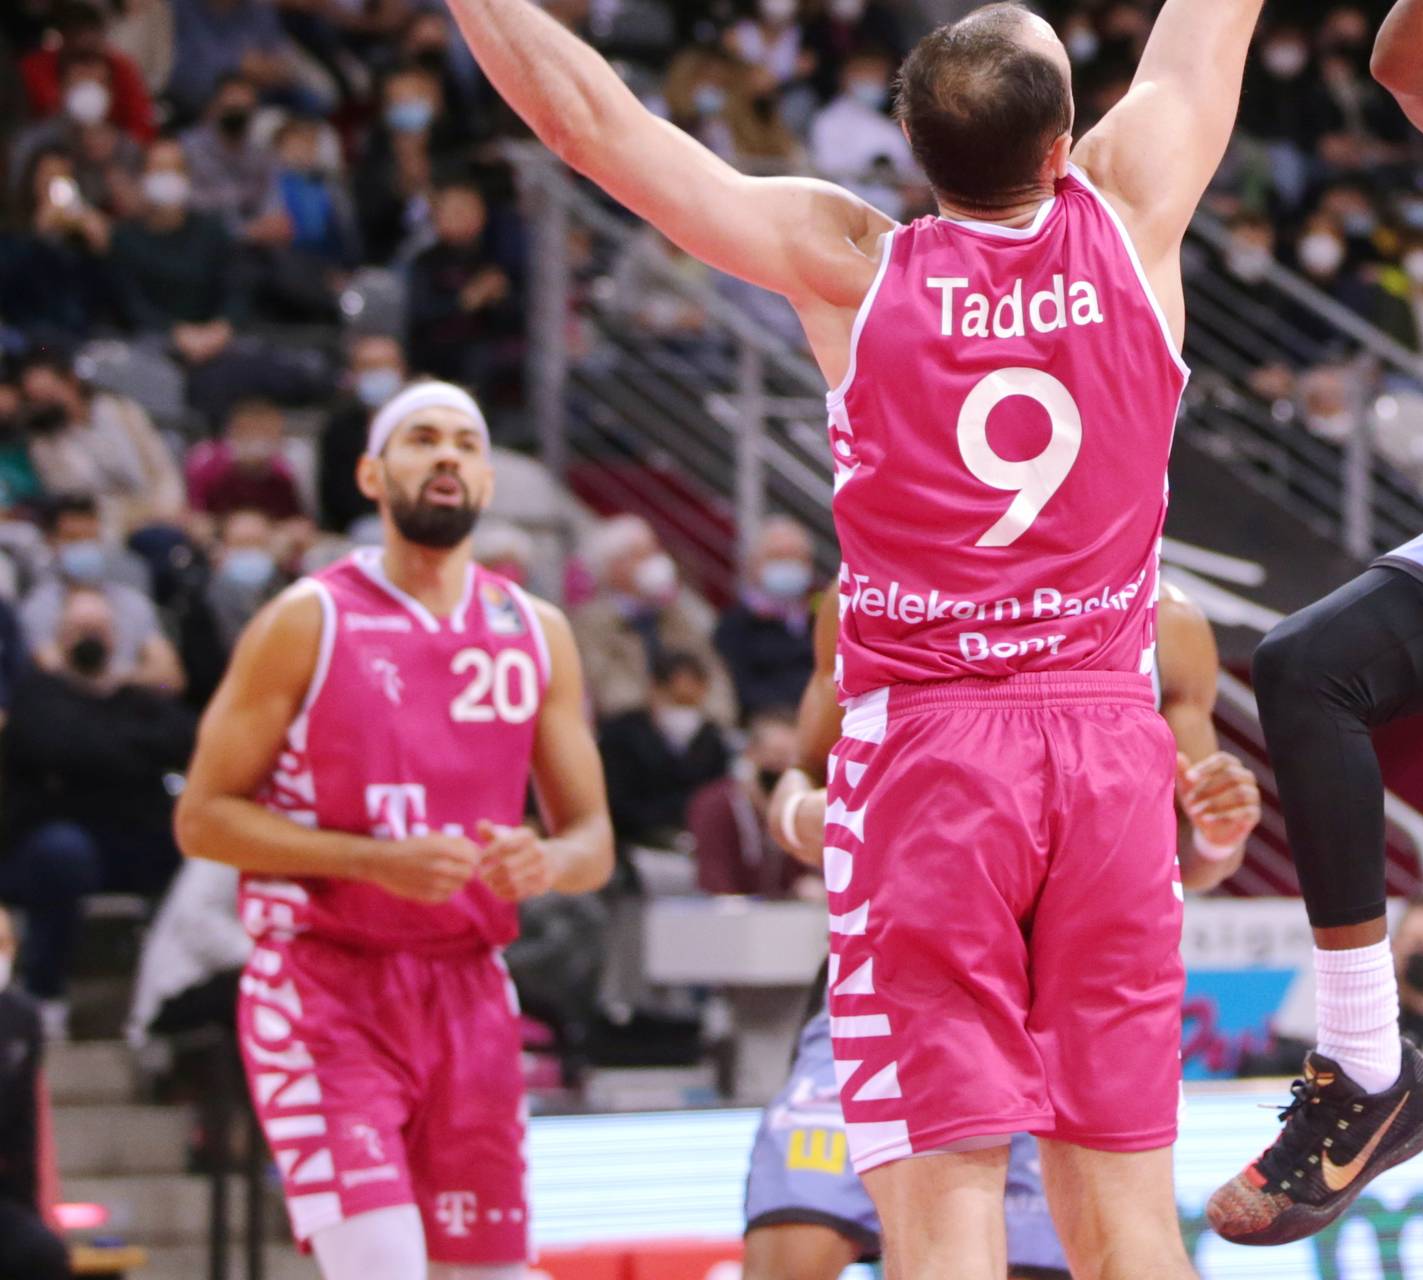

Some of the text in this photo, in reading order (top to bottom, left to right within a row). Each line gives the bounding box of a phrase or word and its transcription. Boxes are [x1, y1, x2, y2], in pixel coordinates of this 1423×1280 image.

[926, 273, 1104, 339] Tadda
[956, 366, 1083, 548] 9
[450, 647, 540, 725] 20
